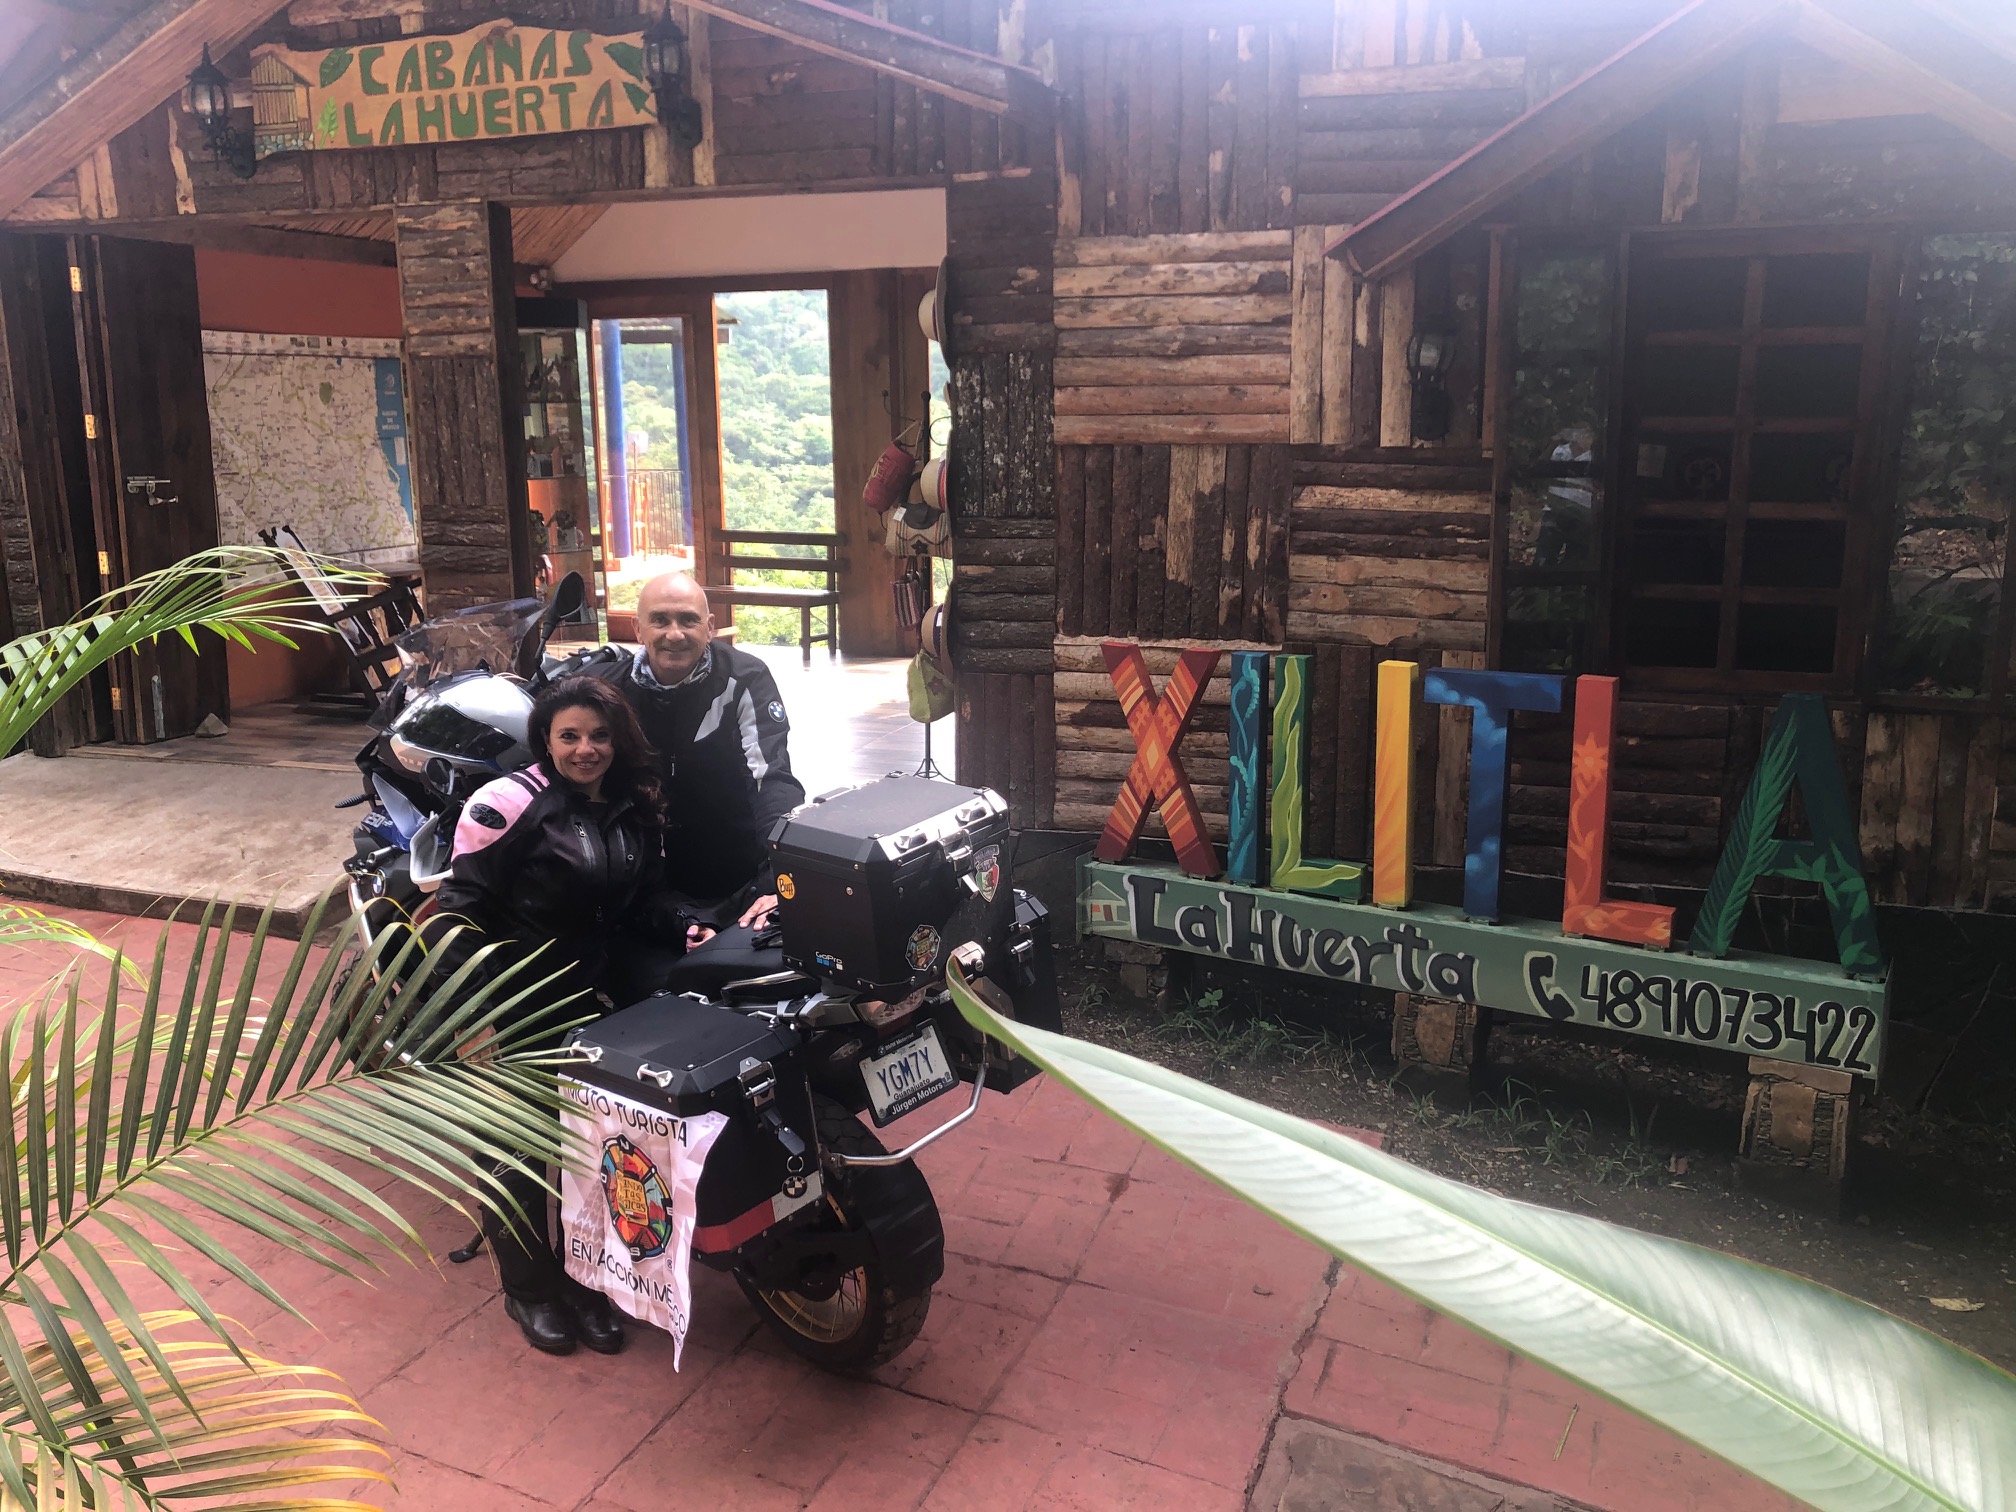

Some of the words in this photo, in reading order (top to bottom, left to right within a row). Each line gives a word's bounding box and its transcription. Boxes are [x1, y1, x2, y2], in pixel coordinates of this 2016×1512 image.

[1094, 641, 1887, 978] XILITLA
[779, 878, 793, 895] Buff
[815, 951, 843, 964] GoPro
[1580, 964, 1880, 1073] 4891073422
[876, 1046, 934, 1097] YGM7Y
[893, 1078, 930, 1100] Guanajuato
[891, 1096, 917, 1115] Jürgen
[916, 1081, 943, 1101] Motors
[614, 1101, 687, 1147] TURISTA
[571, 1238, 592, 1264] EN
[597, 1248, 650, 1297] ACCIÓN
